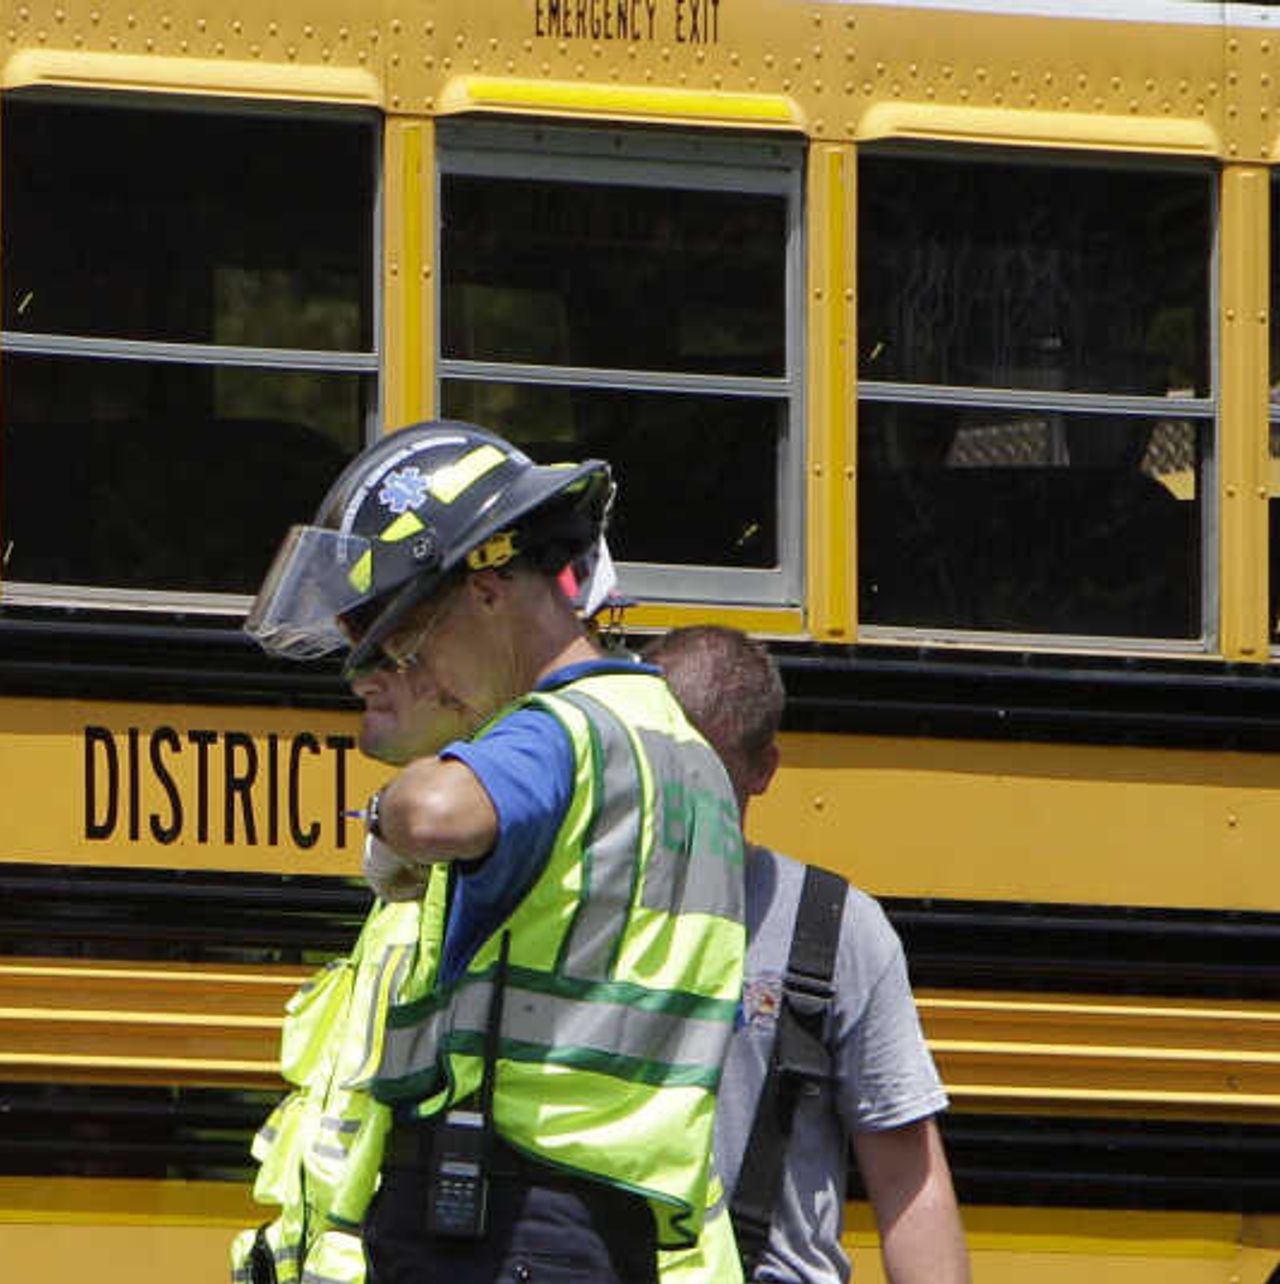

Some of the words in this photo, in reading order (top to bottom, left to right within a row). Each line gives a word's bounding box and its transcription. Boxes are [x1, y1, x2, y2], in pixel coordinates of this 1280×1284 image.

[535, 0, 655, 40] EMERGENCY
[675, 0, 720, 44] EXIT
[84, 725, 355, 849] DISTRICT
